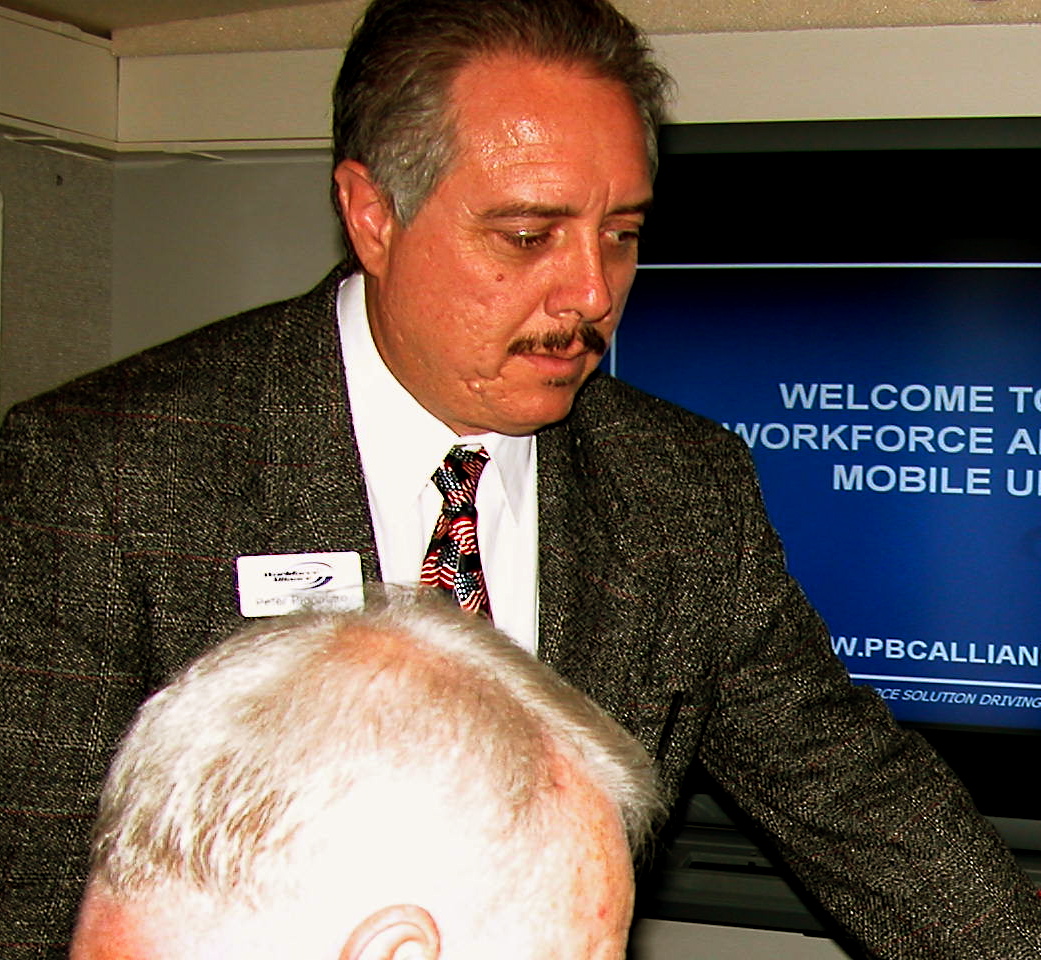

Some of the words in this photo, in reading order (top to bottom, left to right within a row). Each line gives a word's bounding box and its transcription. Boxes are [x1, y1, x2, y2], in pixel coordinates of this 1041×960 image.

[779, 383, 994, 413] WELCOME
[722, 422, 994, 454] WORKFORCE
[833, 464, 992, 495] MOBILE
[901, 688, 980, 705] SOLUTION
